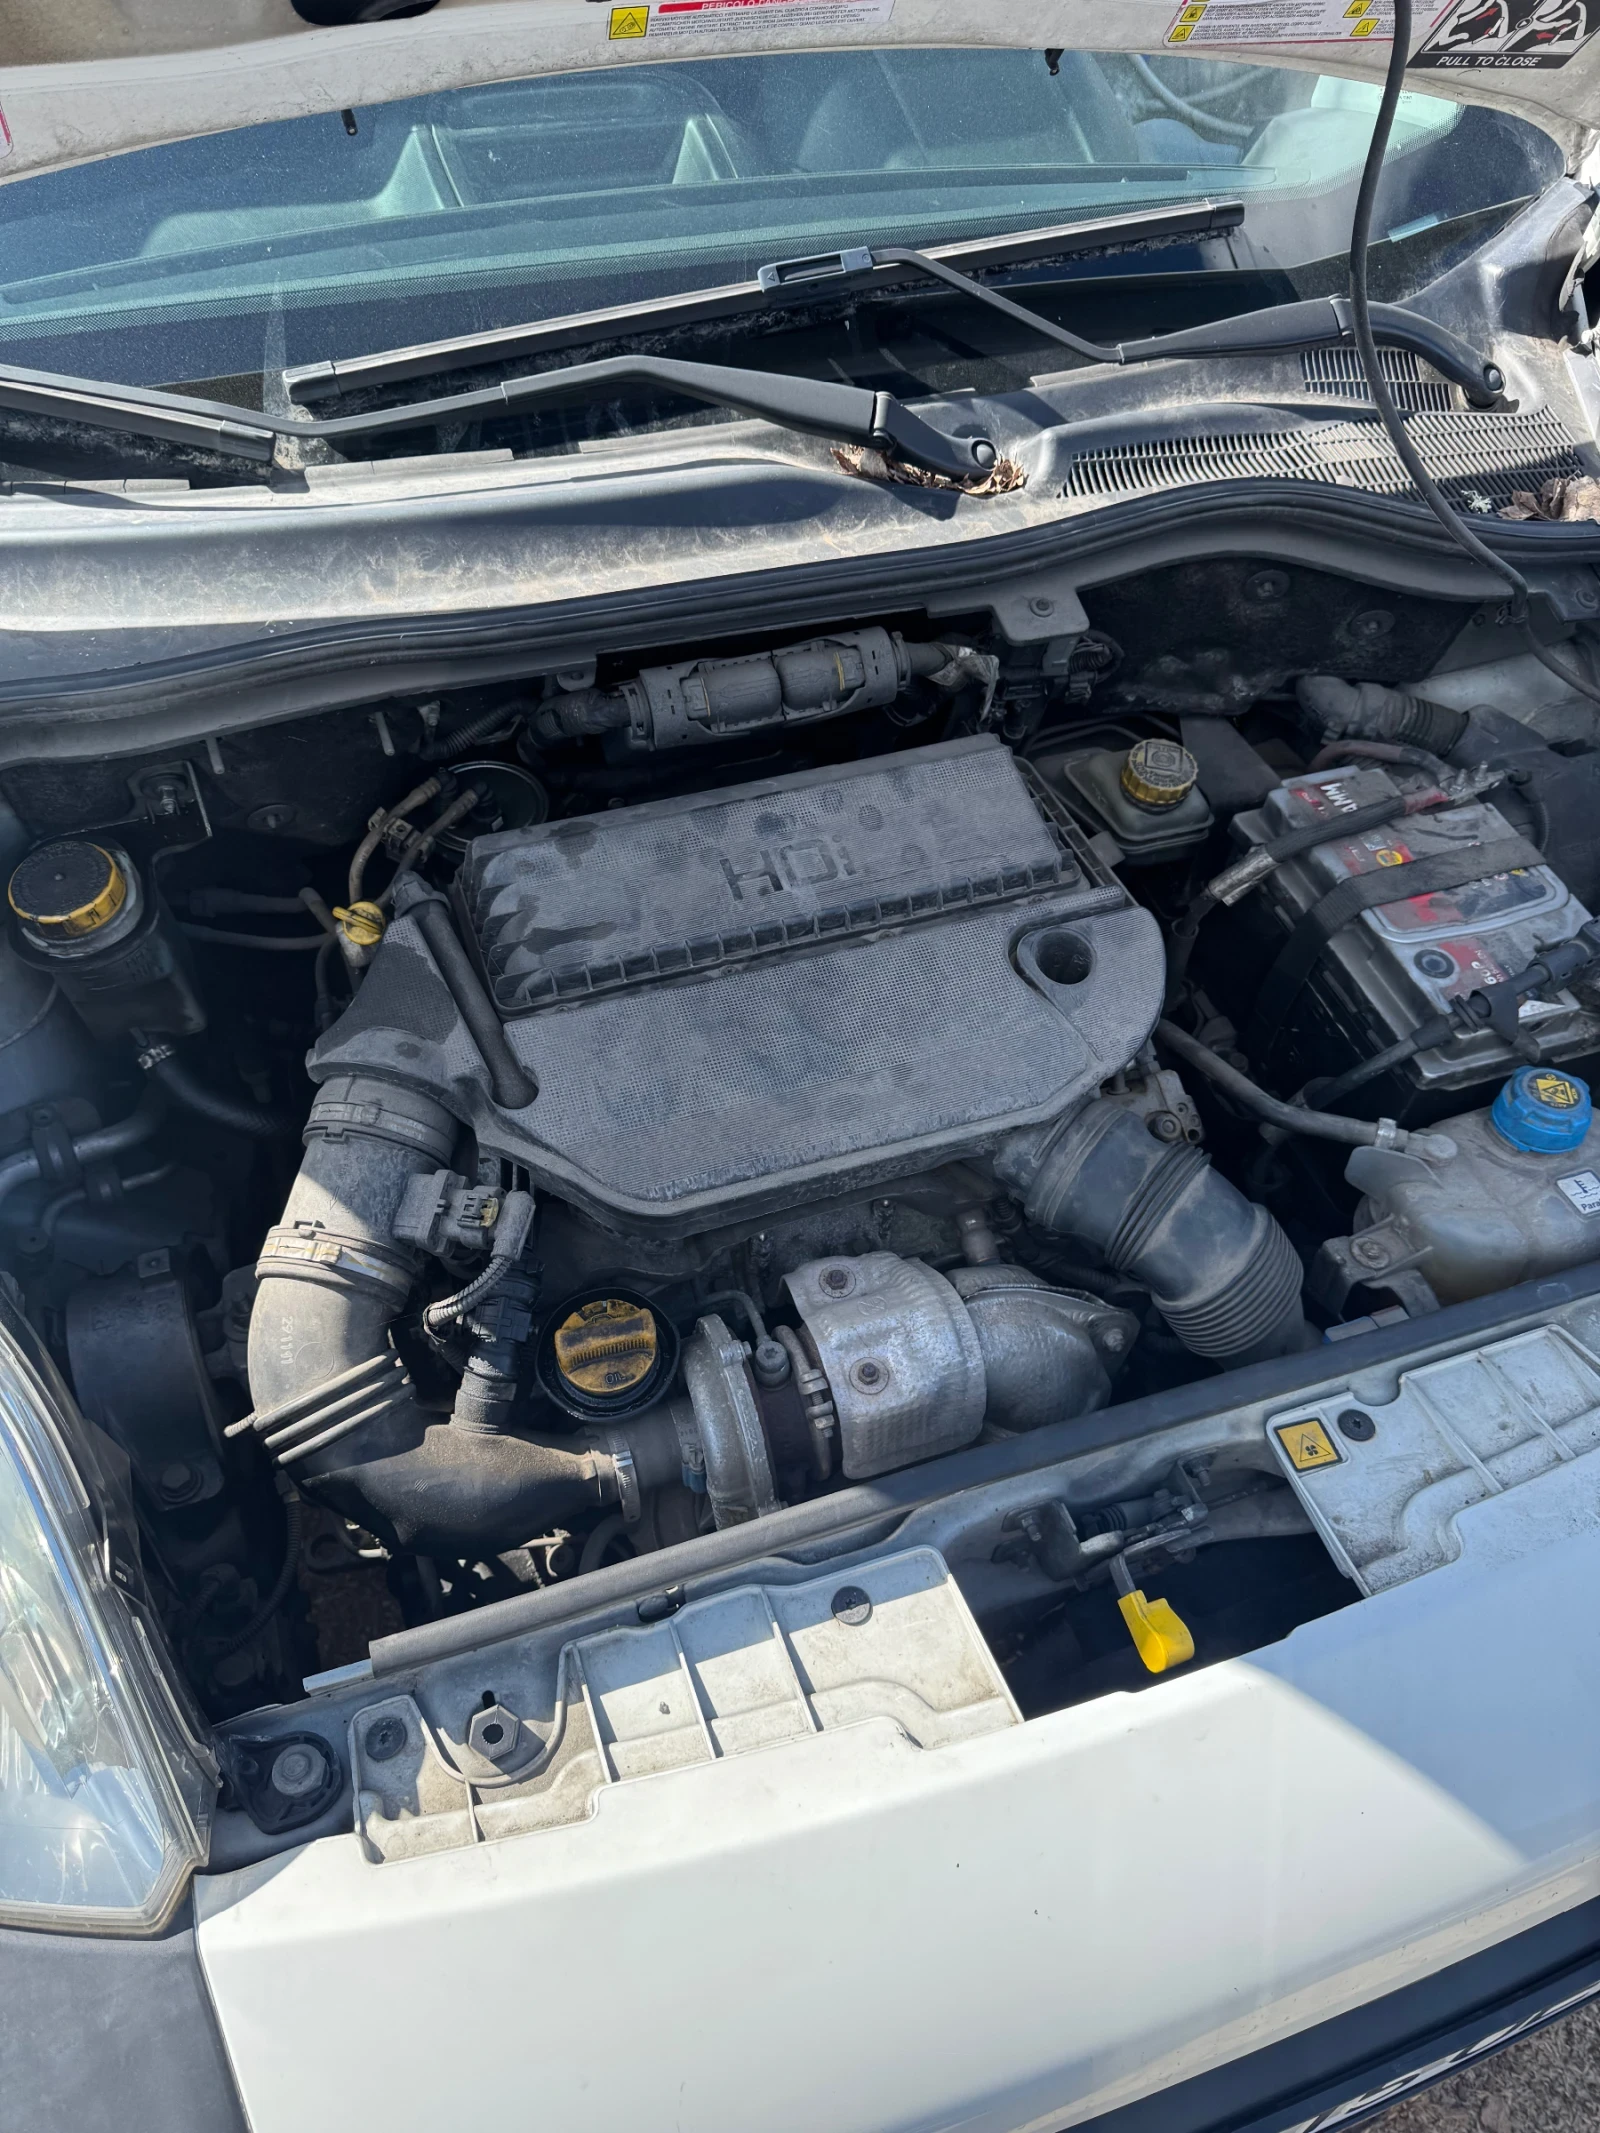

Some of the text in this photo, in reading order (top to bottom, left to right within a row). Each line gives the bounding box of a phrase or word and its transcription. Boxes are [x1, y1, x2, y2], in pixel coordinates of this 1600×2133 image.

[1436, 56, 1542, 66] PULL TO CLOSE
[605, 1373, 627, 1384] OIL
